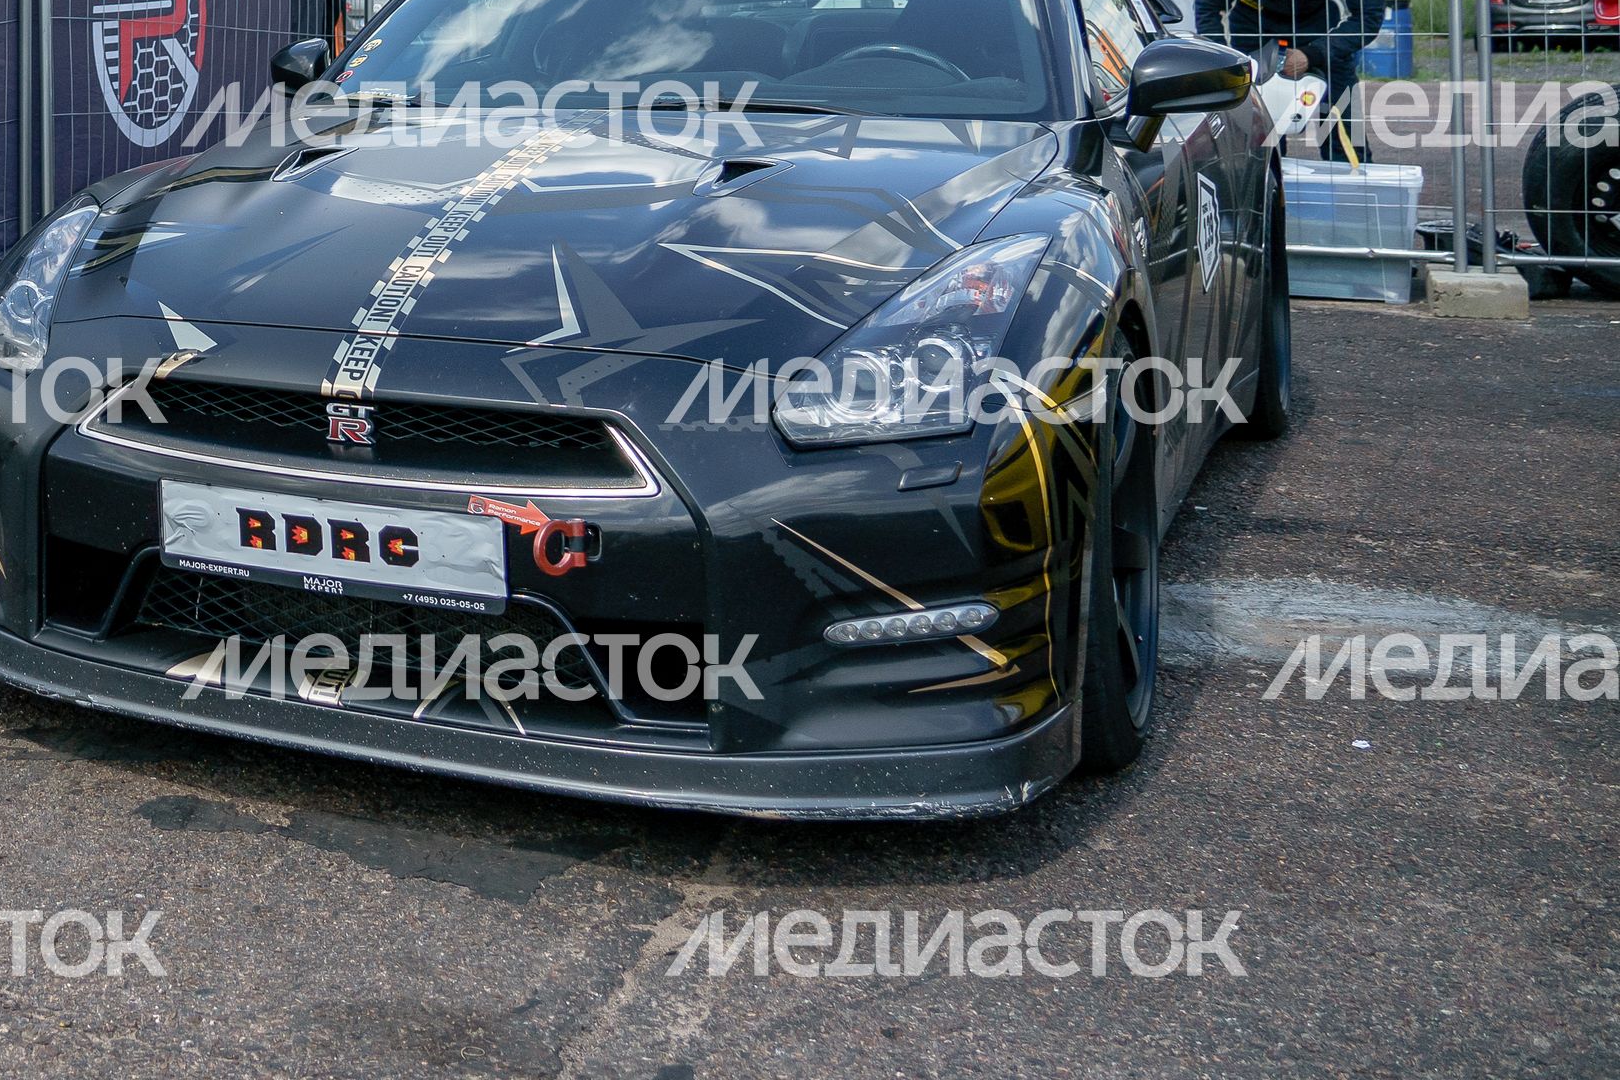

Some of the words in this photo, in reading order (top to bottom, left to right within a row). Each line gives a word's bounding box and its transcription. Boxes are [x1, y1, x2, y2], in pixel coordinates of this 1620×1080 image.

[437, 210, 476, 235] KEEP
[412, 236, 450, 259] OUT!
[366, 265, 425, 323] CAUTION!
[341, 336, 381, 383] KEEP
[326, 403, 374, 418] GT
[326, 416, 373, 444] R
[488, 504, 517, 514] Ramon
[235, 507, 420, 568] RDRC
[179, 559, 250, 577] MAJOR-EXPERT.RU
[303, 575, 343, 589] MAJOR
[304, 584, 344, 595] EXPERT
[402, 593, 413, 601] +7
[414, 594, 438, 605] (495)
[440, 598, 485, 611] 025-05-05
